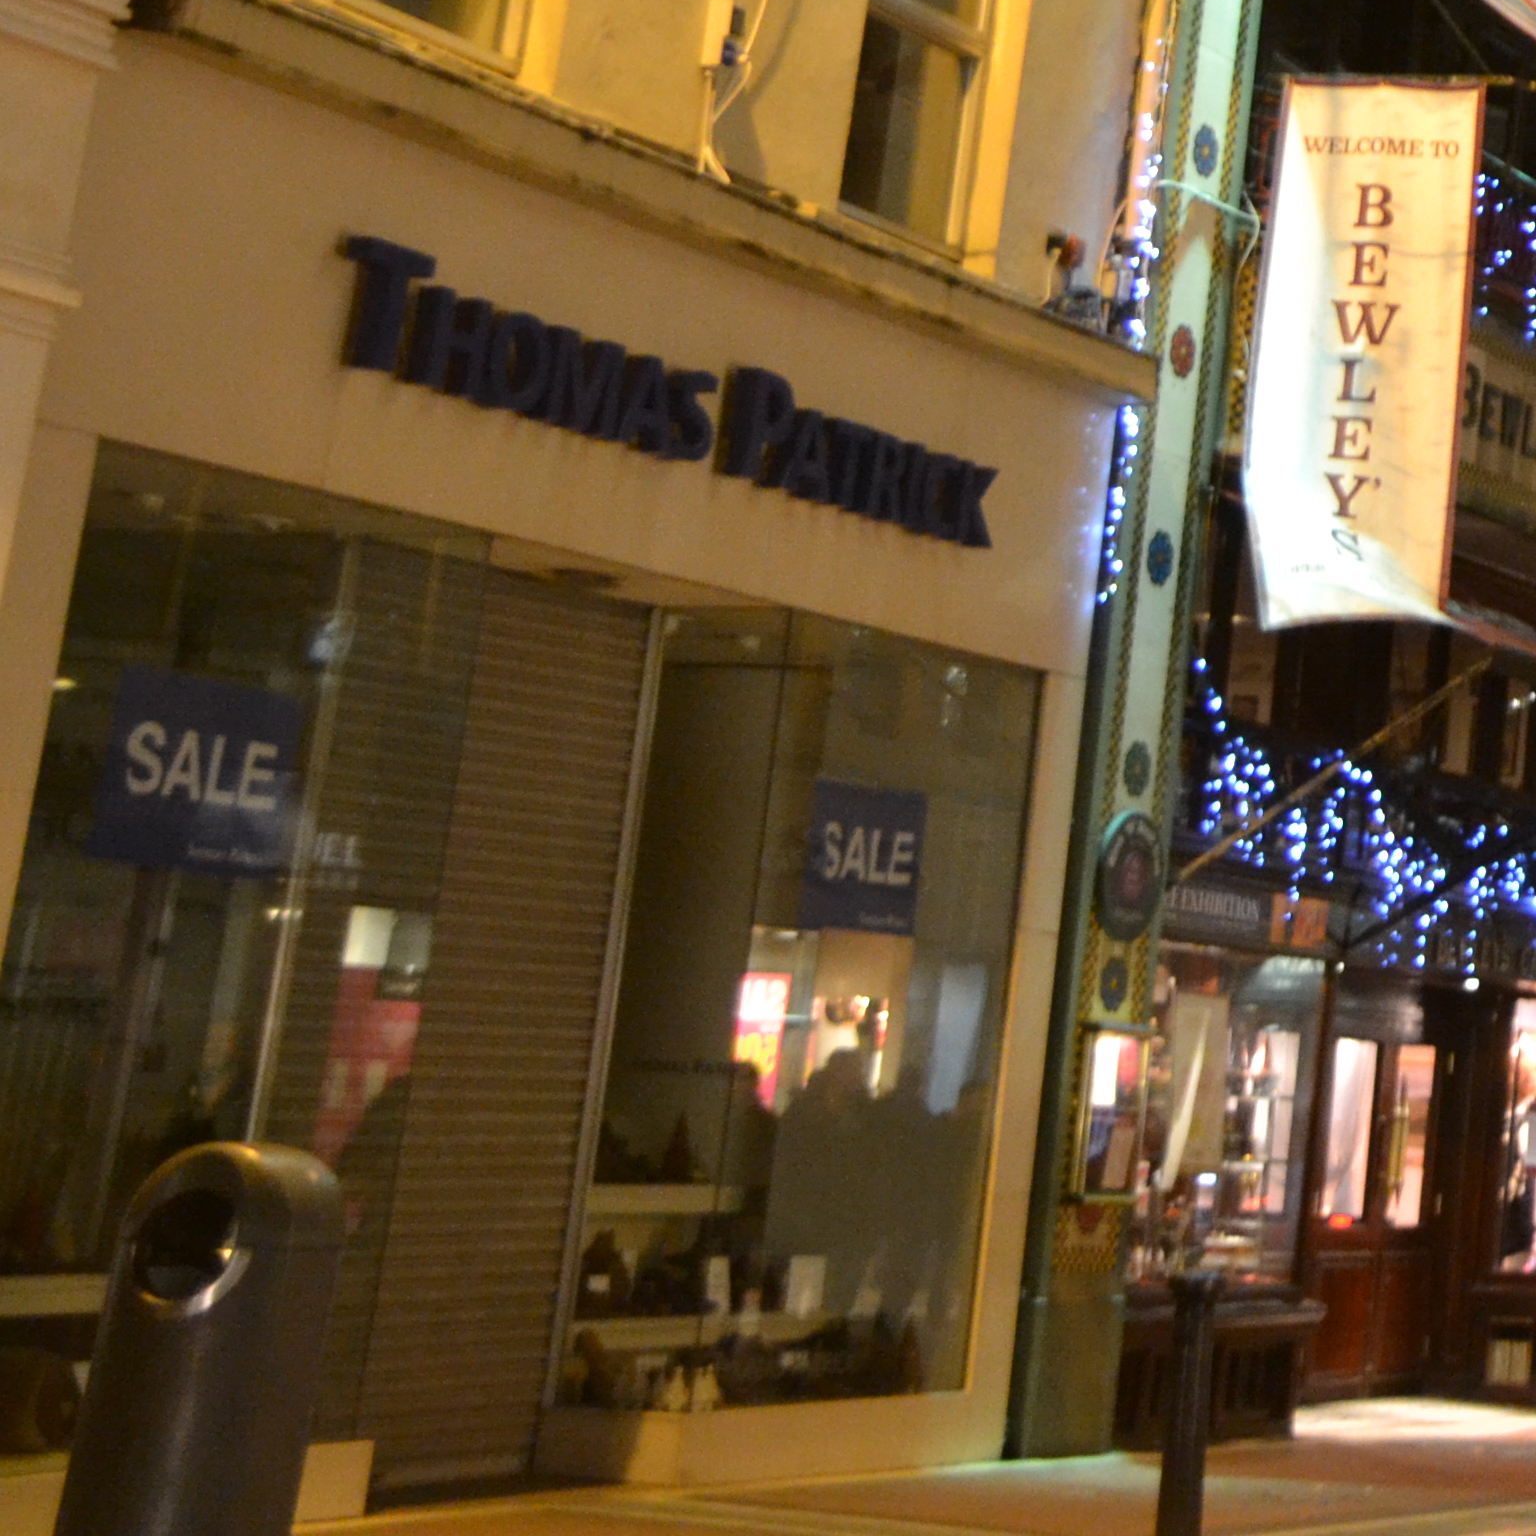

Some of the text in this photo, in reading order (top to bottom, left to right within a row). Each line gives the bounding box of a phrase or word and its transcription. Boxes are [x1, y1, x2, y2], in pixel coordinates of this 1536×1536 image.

[1303, 135, 1461, 159] WELCOME TO
[335, 233, 999, 548] THOMAS PATRICK
[126, 720, 279, 811] SALE
[823, 820, 915, 886] SALE
